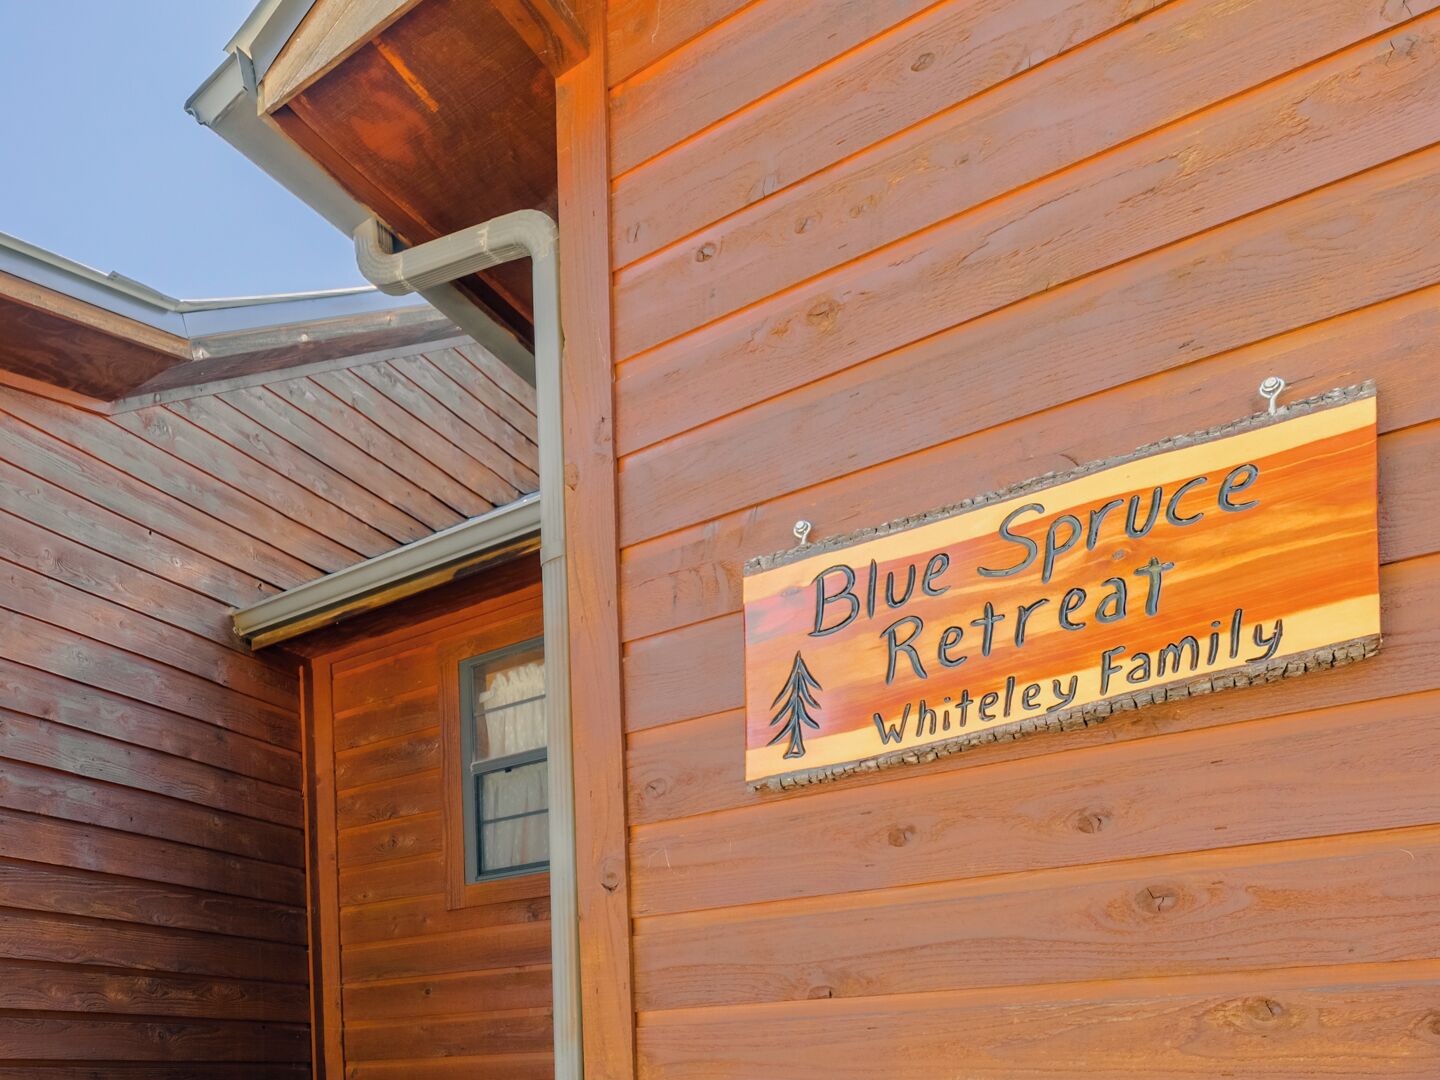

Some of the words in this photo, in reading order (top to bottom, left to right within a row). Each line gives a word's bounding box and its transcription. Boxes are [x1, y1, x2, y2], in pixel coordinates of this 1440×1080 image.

[807, 552, 951, 638] Blue
[975, 462, 1260, 584] Spruce
[872, 675, 1078, 747] Whiteley
[1100, 608, 1284, 696] Family
[879, 556, 1175, 686] Retreat
